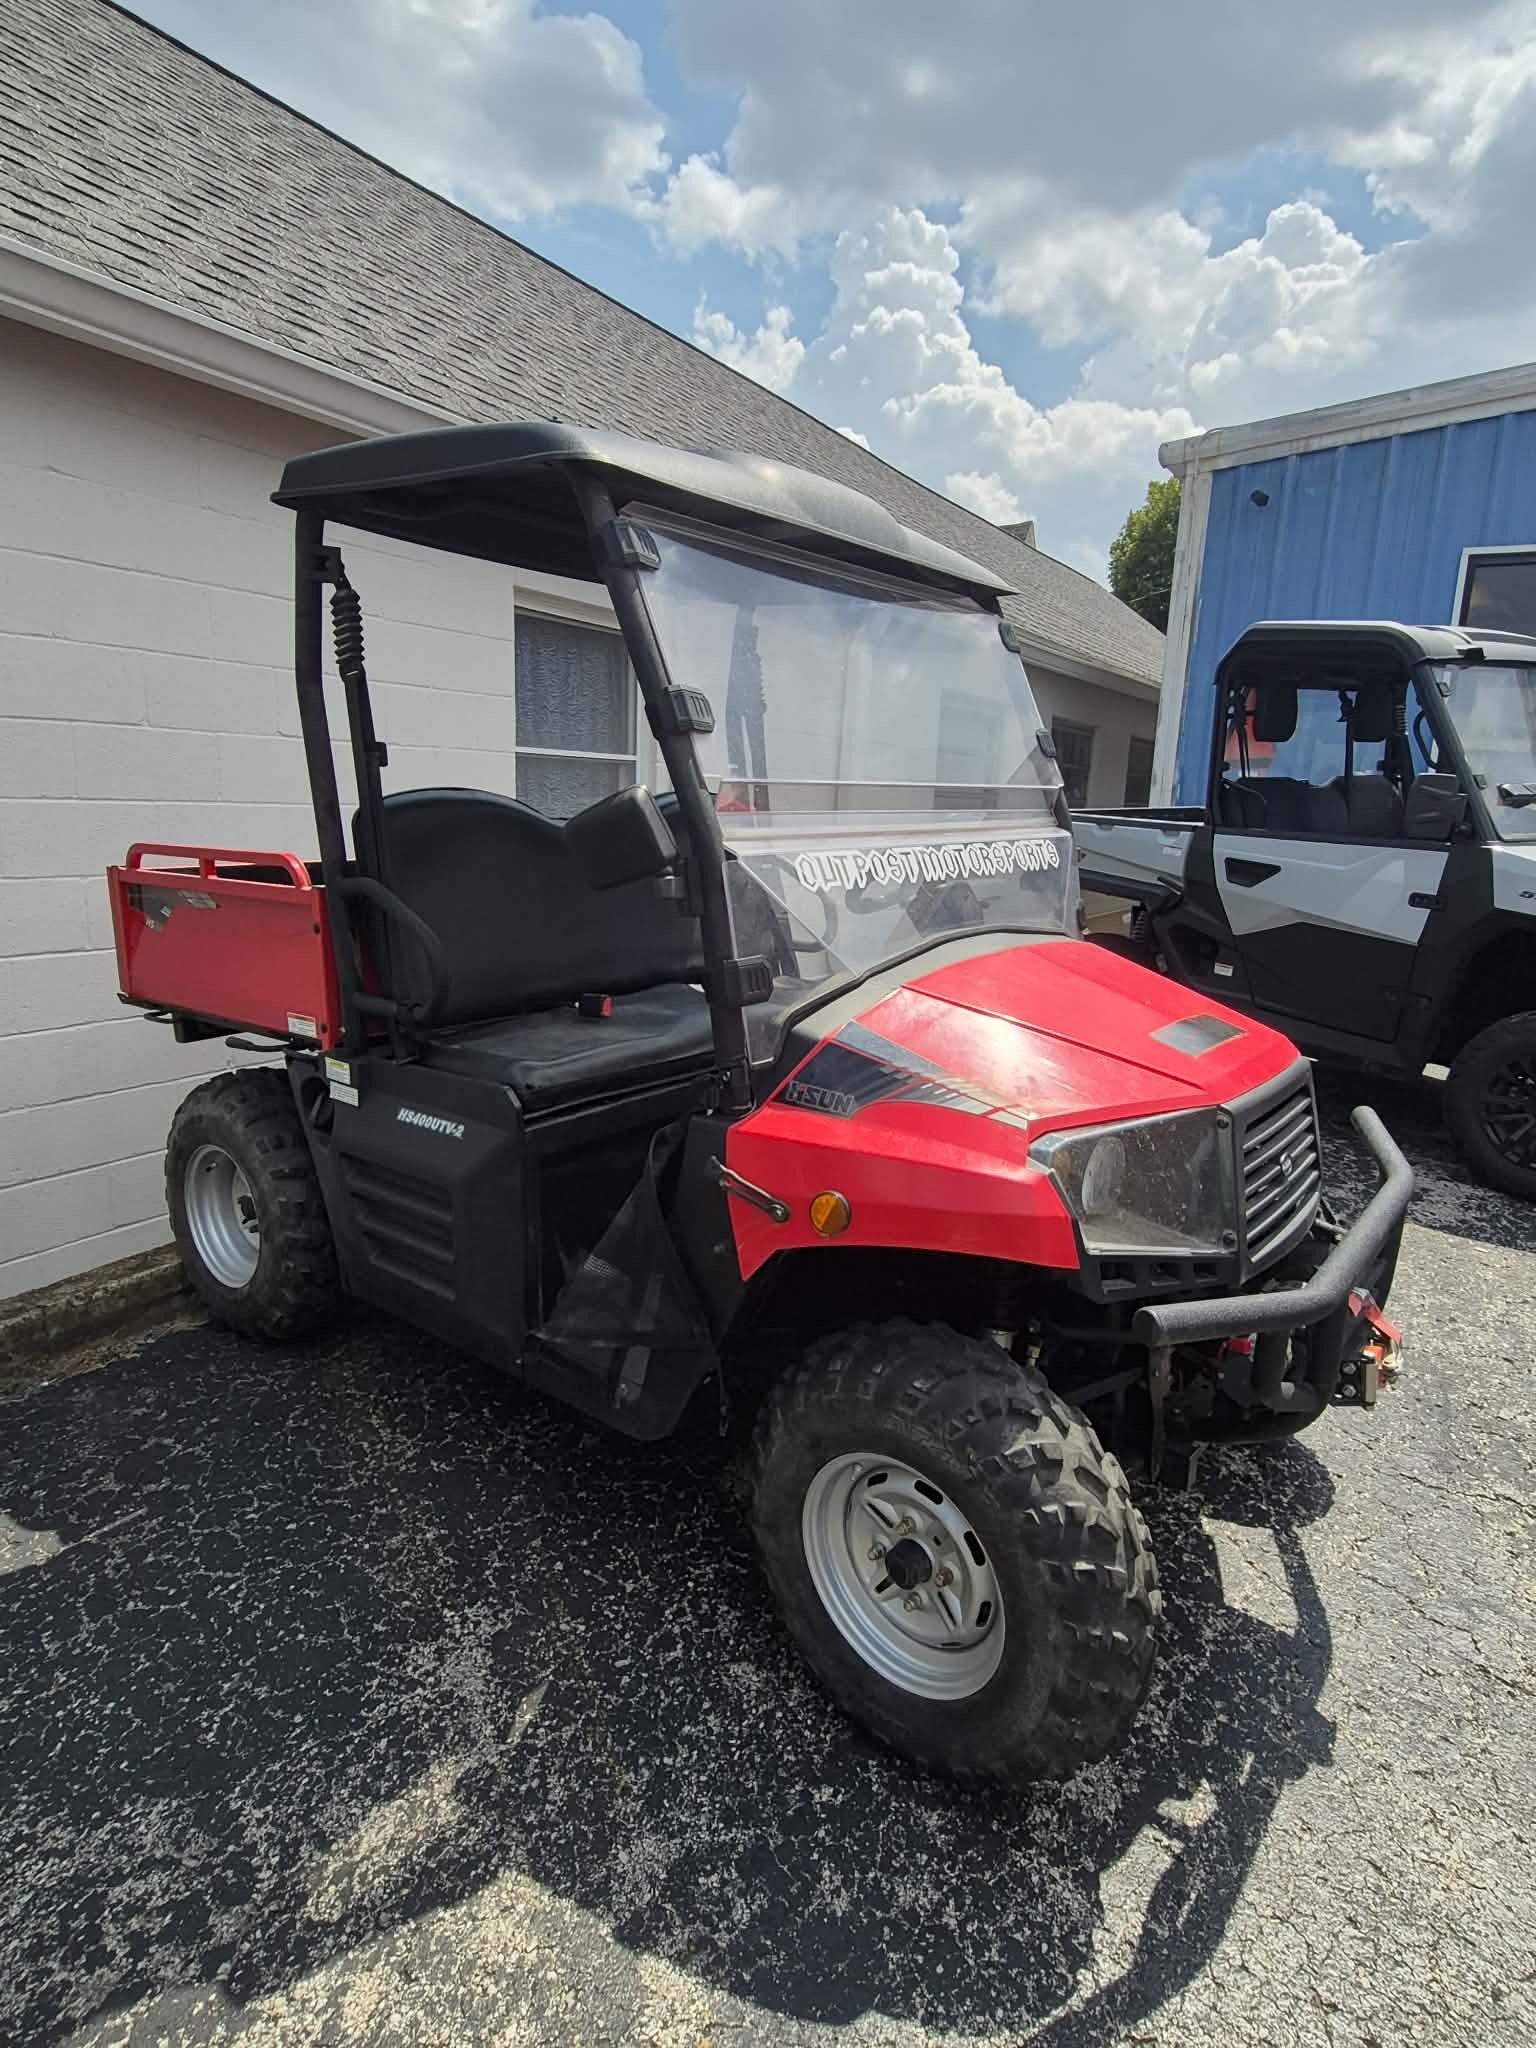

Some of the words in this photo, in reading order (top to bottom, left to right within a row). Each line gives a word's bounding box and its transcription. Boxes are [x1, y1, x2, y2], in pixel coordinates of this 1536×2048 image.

[794, 847, 919, 893] OUTPOST
[917, 839, 1060, 883] MOTORSPORTS
[397, 1107, 465, 1139] HS400UTV-2
